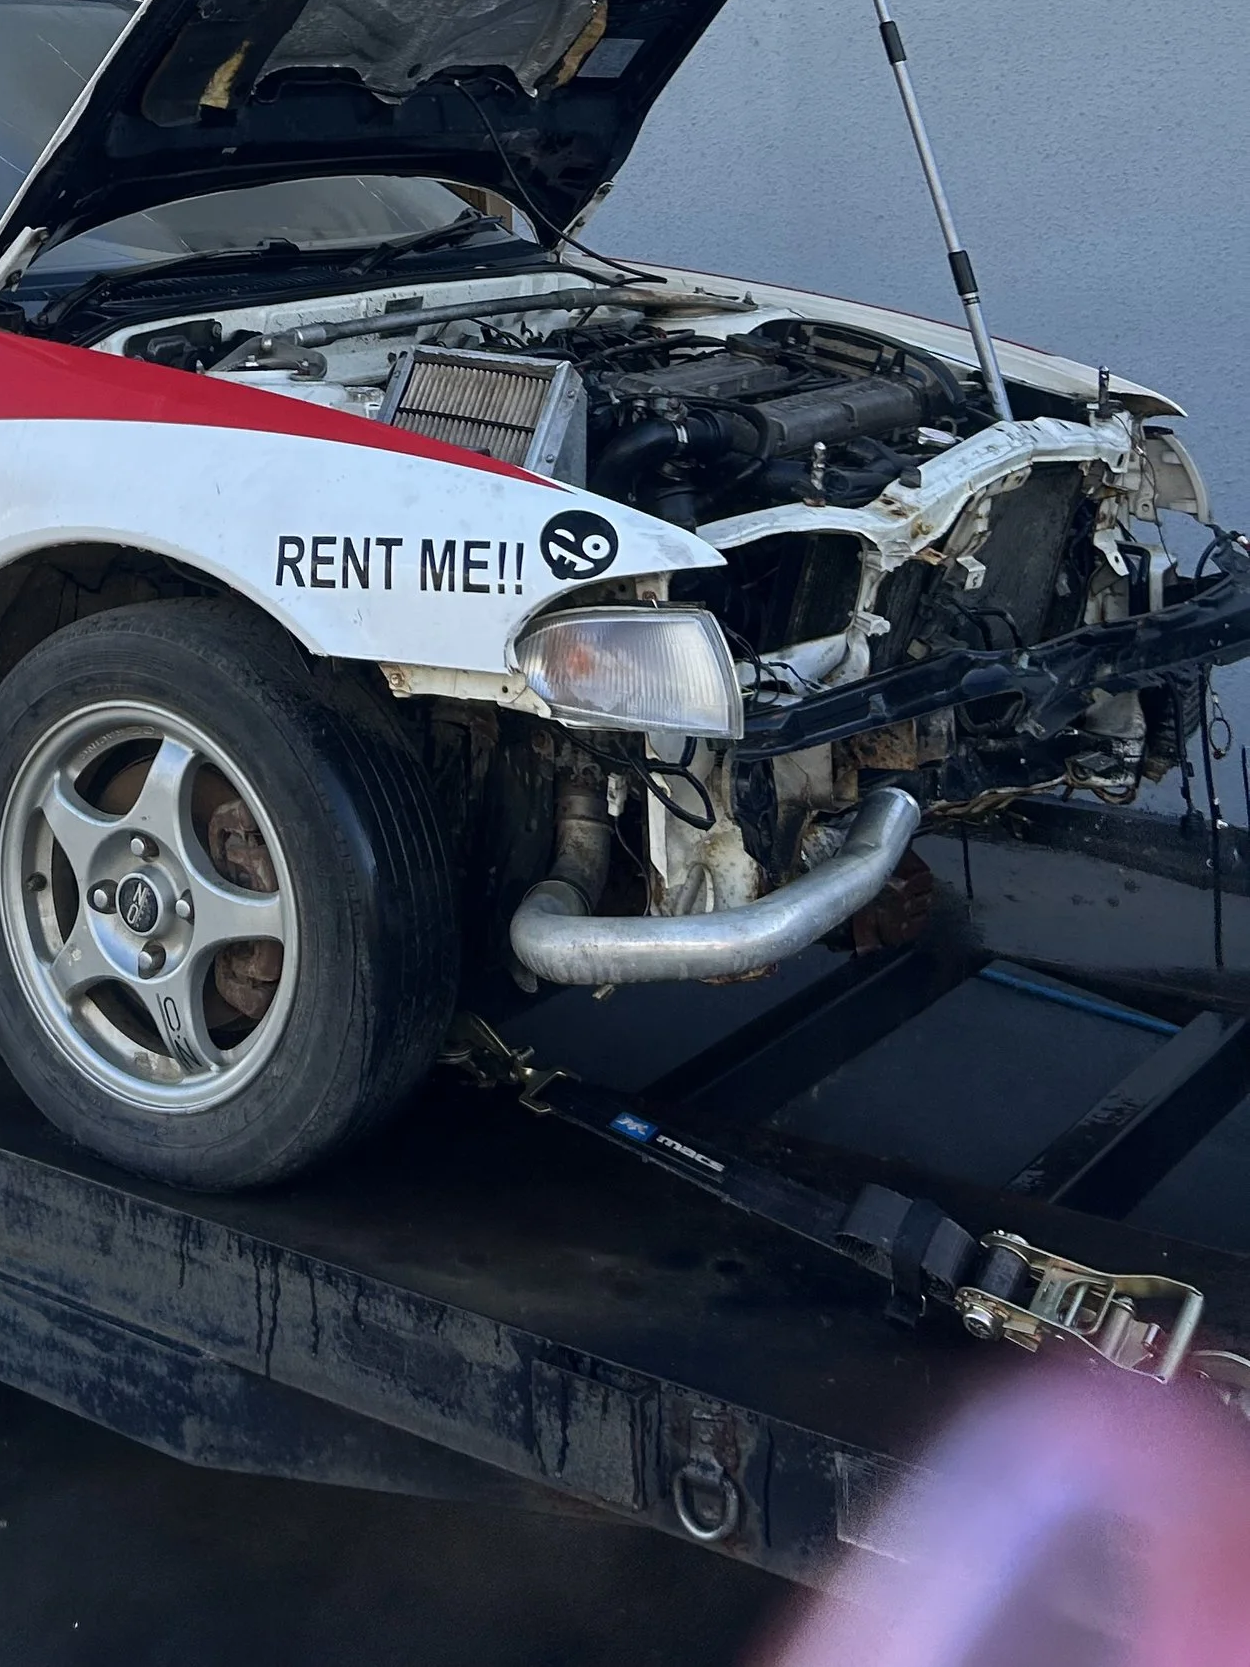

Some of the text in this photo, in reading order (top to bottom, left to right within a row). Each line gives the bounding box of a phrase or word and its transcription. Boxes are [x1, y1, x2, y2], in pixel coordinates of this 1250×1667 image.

[275, 535, 524, 595] RENT ME!!
[655, 1134, 726, 1173] macs
